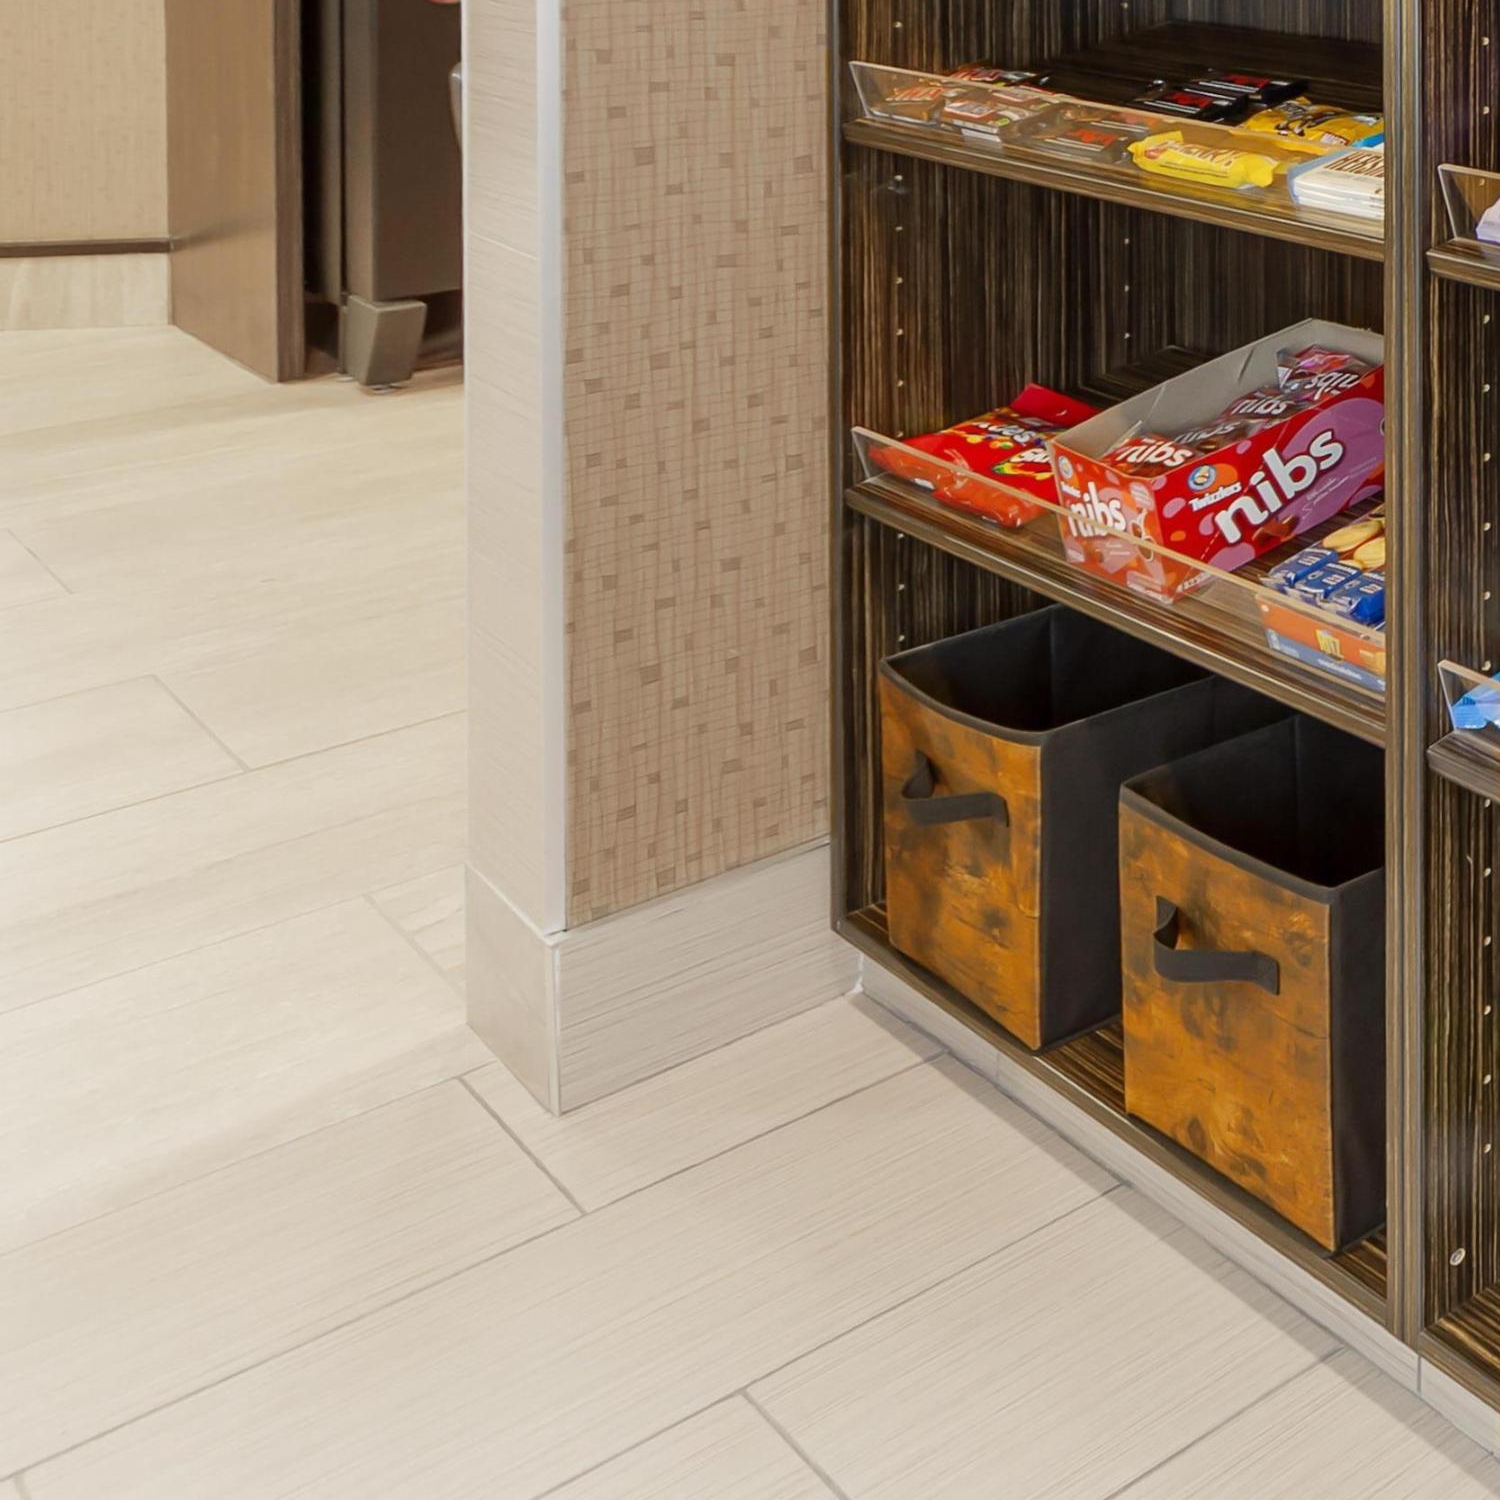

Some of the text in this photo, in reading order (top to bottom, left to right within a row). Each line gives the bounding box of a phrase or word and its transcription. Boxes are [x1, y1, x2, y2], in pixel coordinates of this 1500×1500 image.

[1117, 441, 1195, 468] nibs
[1068, 481, 1127, 539] nibs
[1215, 430, 1344, 544] nibs
